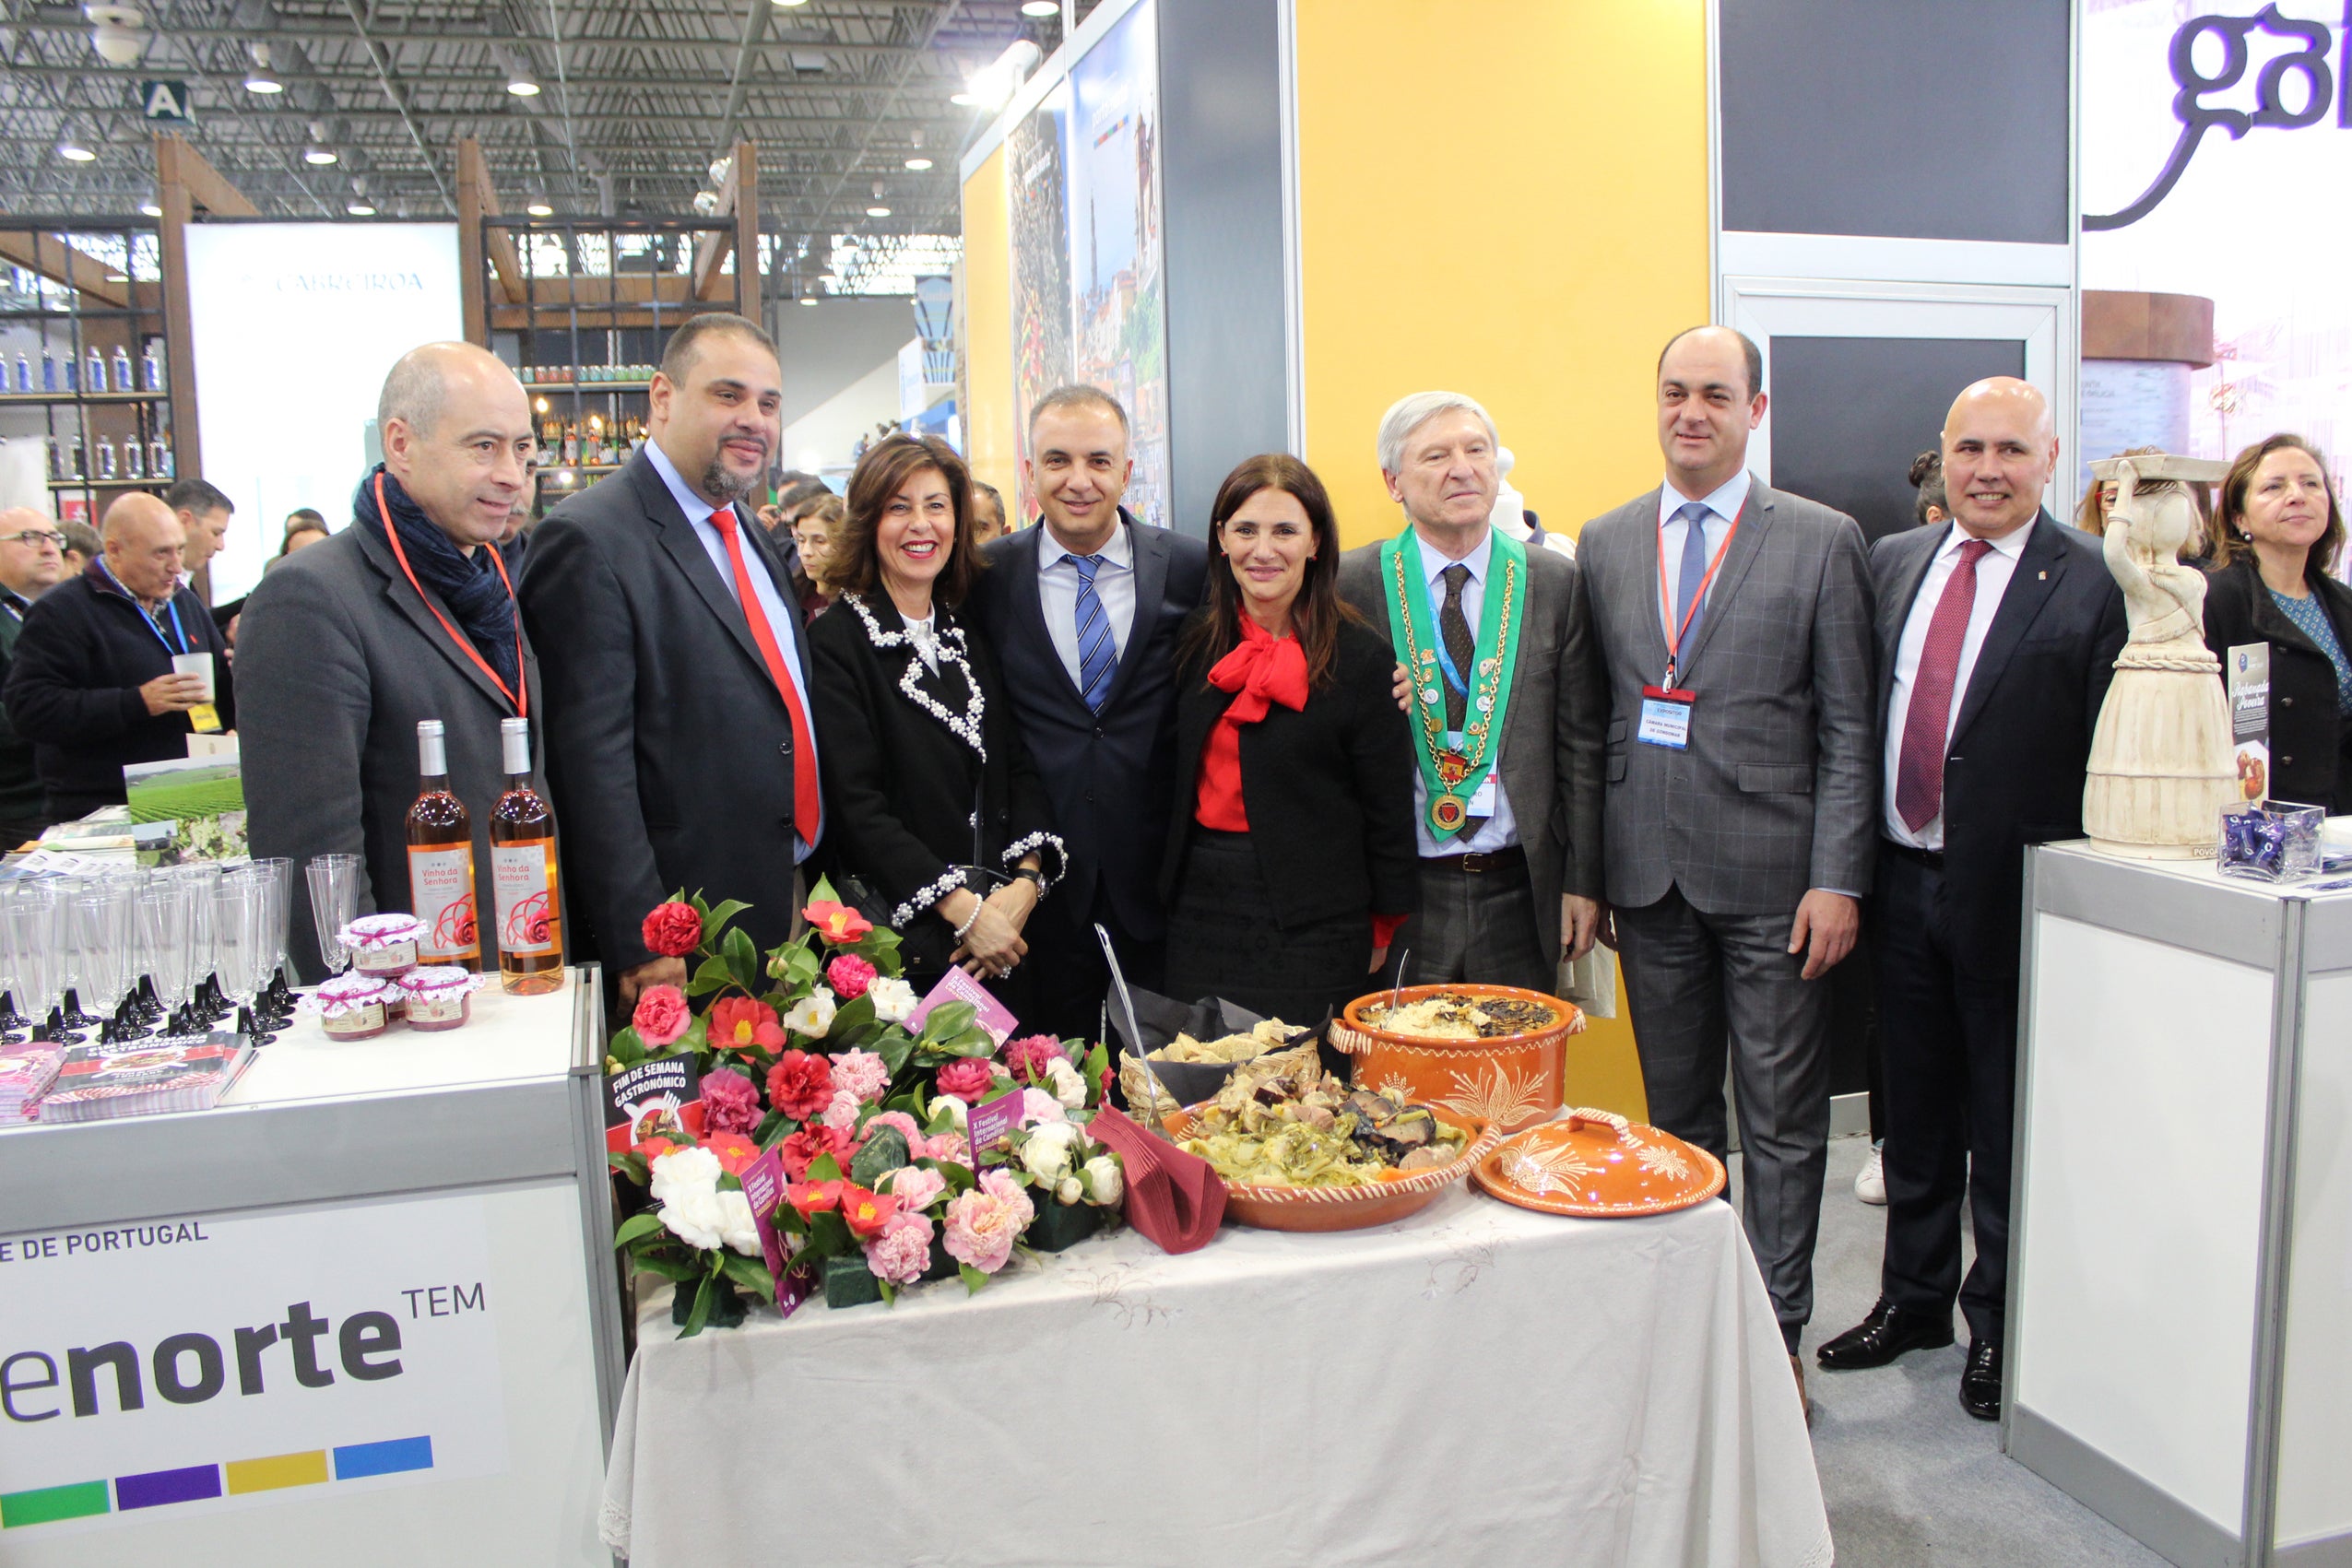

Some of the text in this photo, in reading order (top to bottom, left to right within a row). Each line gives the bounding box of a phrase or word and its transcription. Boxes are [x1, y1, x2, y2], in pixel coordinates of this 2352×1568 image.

[147, 83, 183, 117] A
[498, 873, 530, 881] Senhora
[518, 865, 530, 873] da
[144, 1034, 208, 1043] SEMANA
[612, 1061, 685, 1093] FIM DE SEMANA
[614, 1075, 686, 1107] GASTRONÓMICO
[974, 1115, 1008, 1138] Internacional
[978, 1113, 999, 1128] Festival
[975, 1138, 983, 1146] de
[751, 1172, 766, 1191] Festival
[751, 1174, 774, 1201] Internacional
[22, 1237, 58, 1260] DE
[66, 1221, 208, 1255] PORTUGAL
[0, 1282, 486, 1422] enorte TEM
